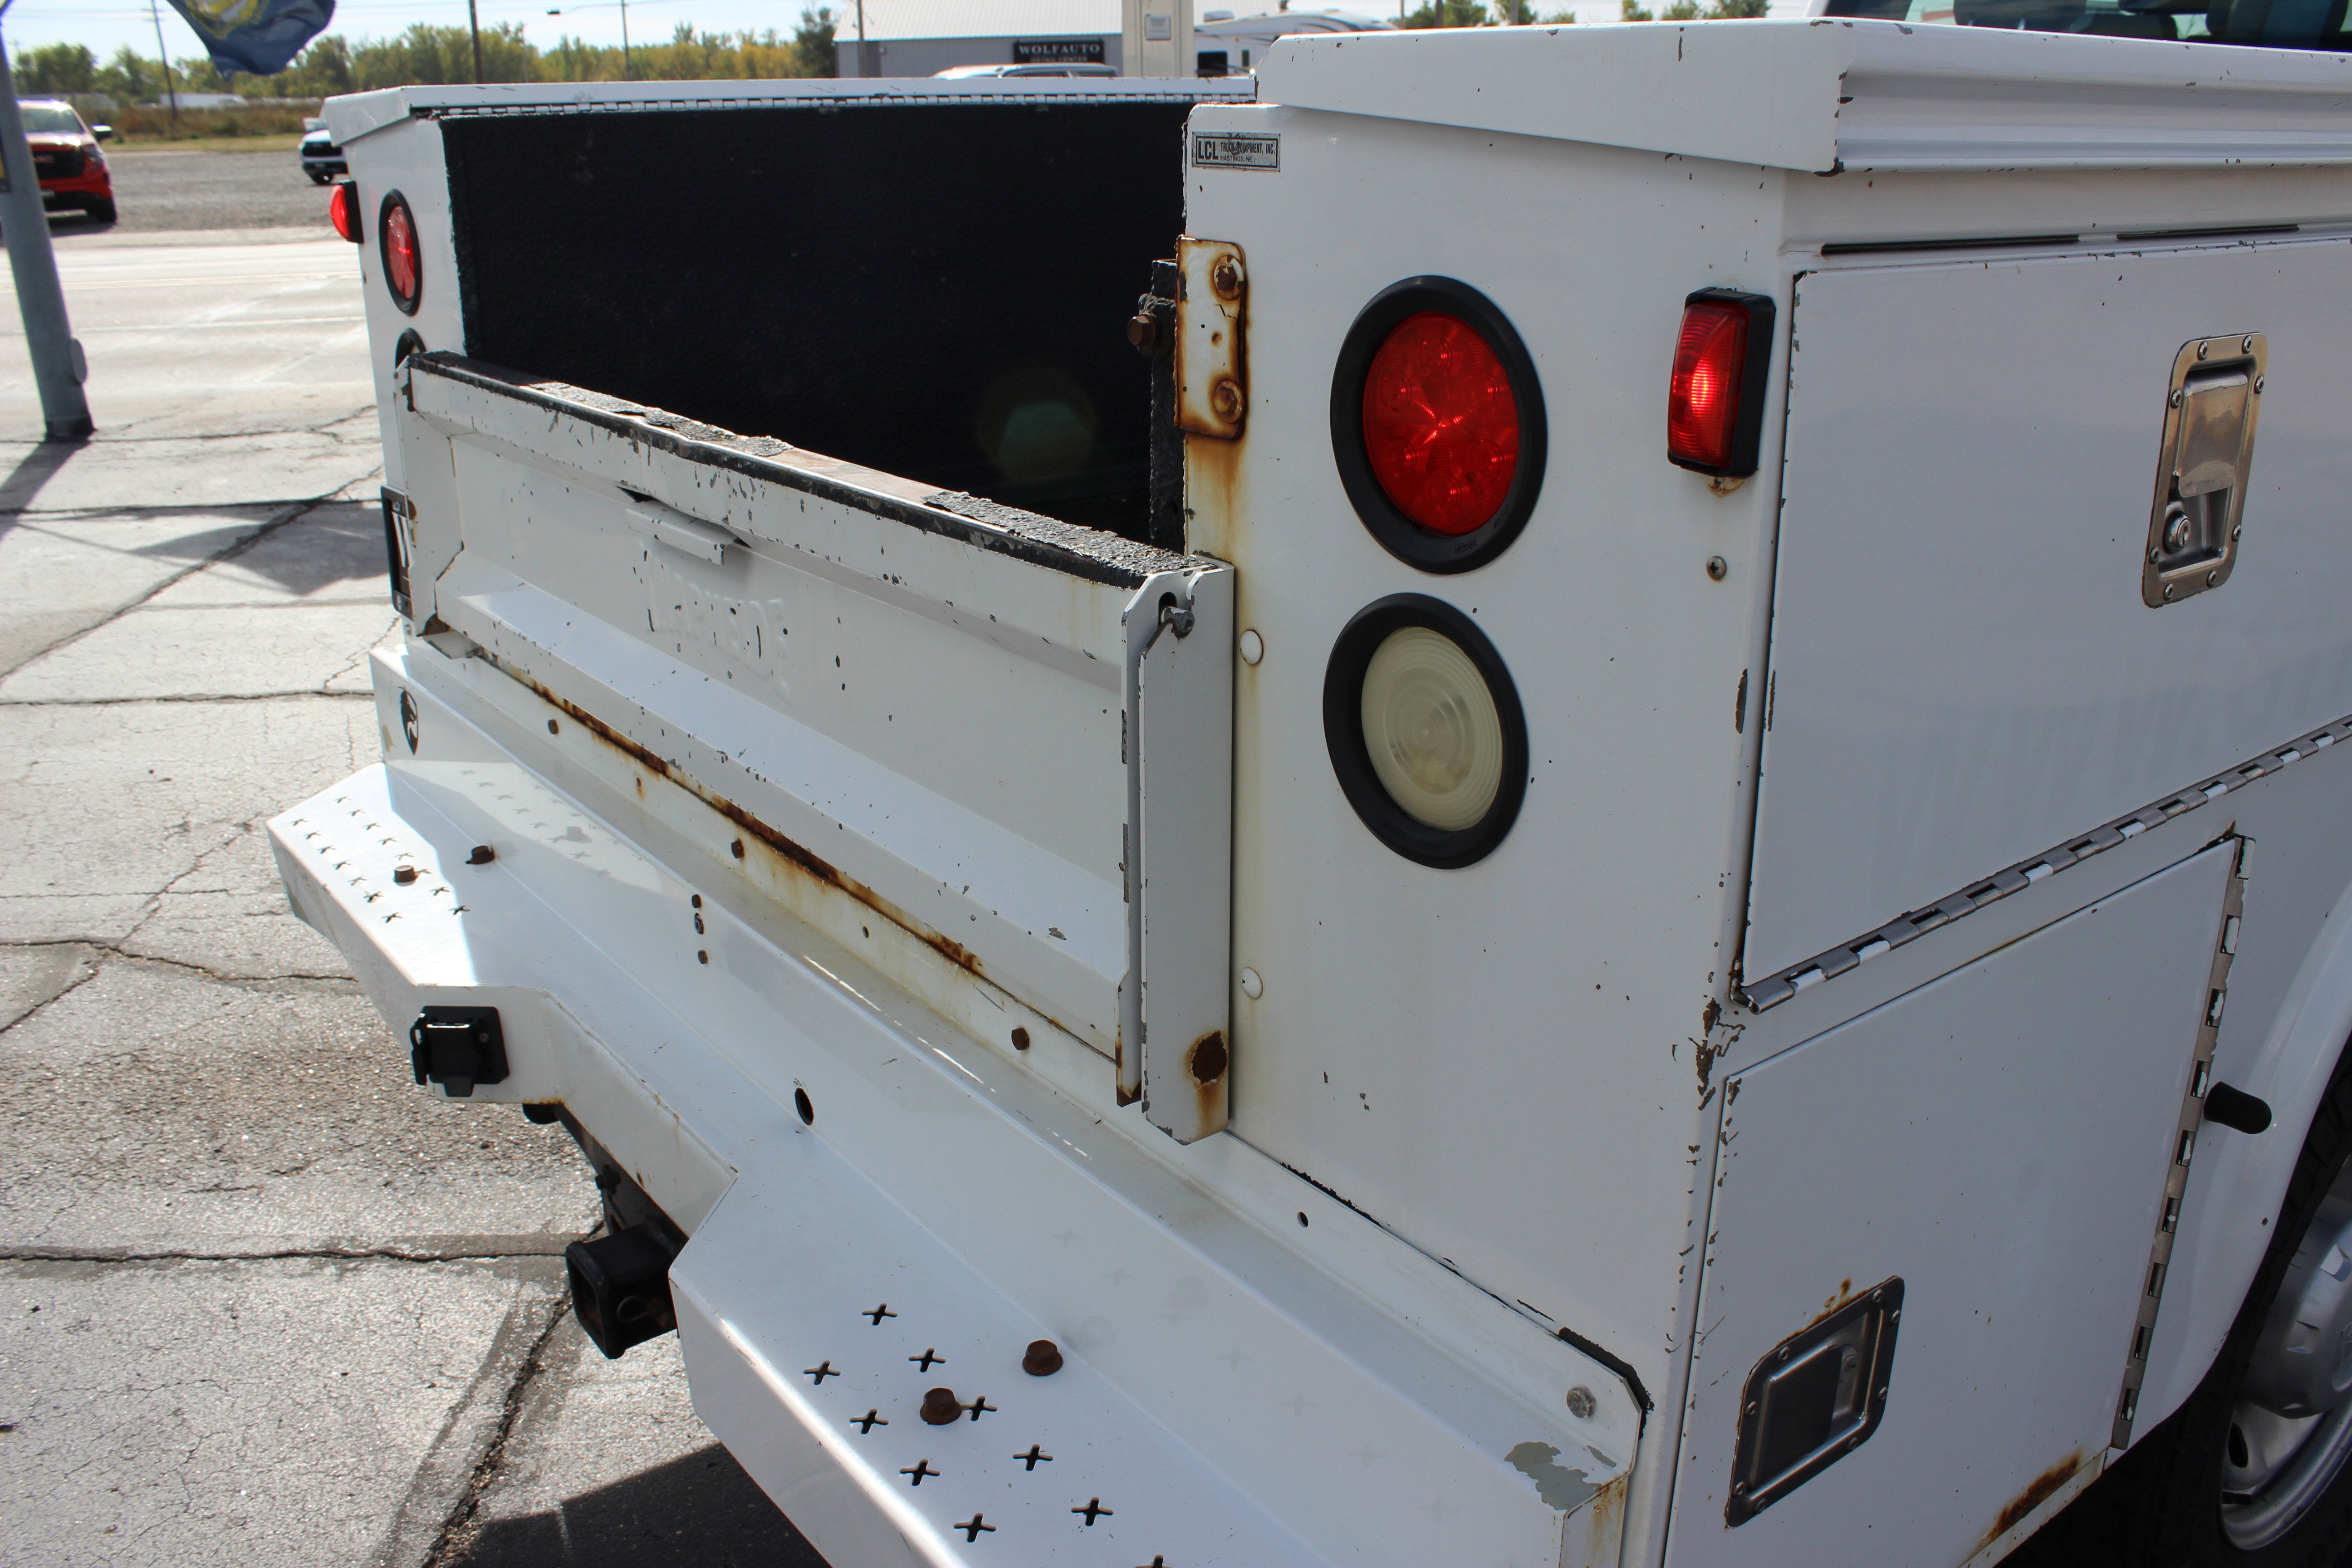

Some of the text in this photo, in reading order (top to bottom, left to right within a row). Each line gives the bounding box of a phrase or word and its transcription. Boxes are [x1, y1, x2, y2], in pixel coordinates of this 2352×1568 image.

[1198, 141, 1219, 160] LCL
[1220, 142, 1275, 155] TRUCK QUIPMENT, INC.
